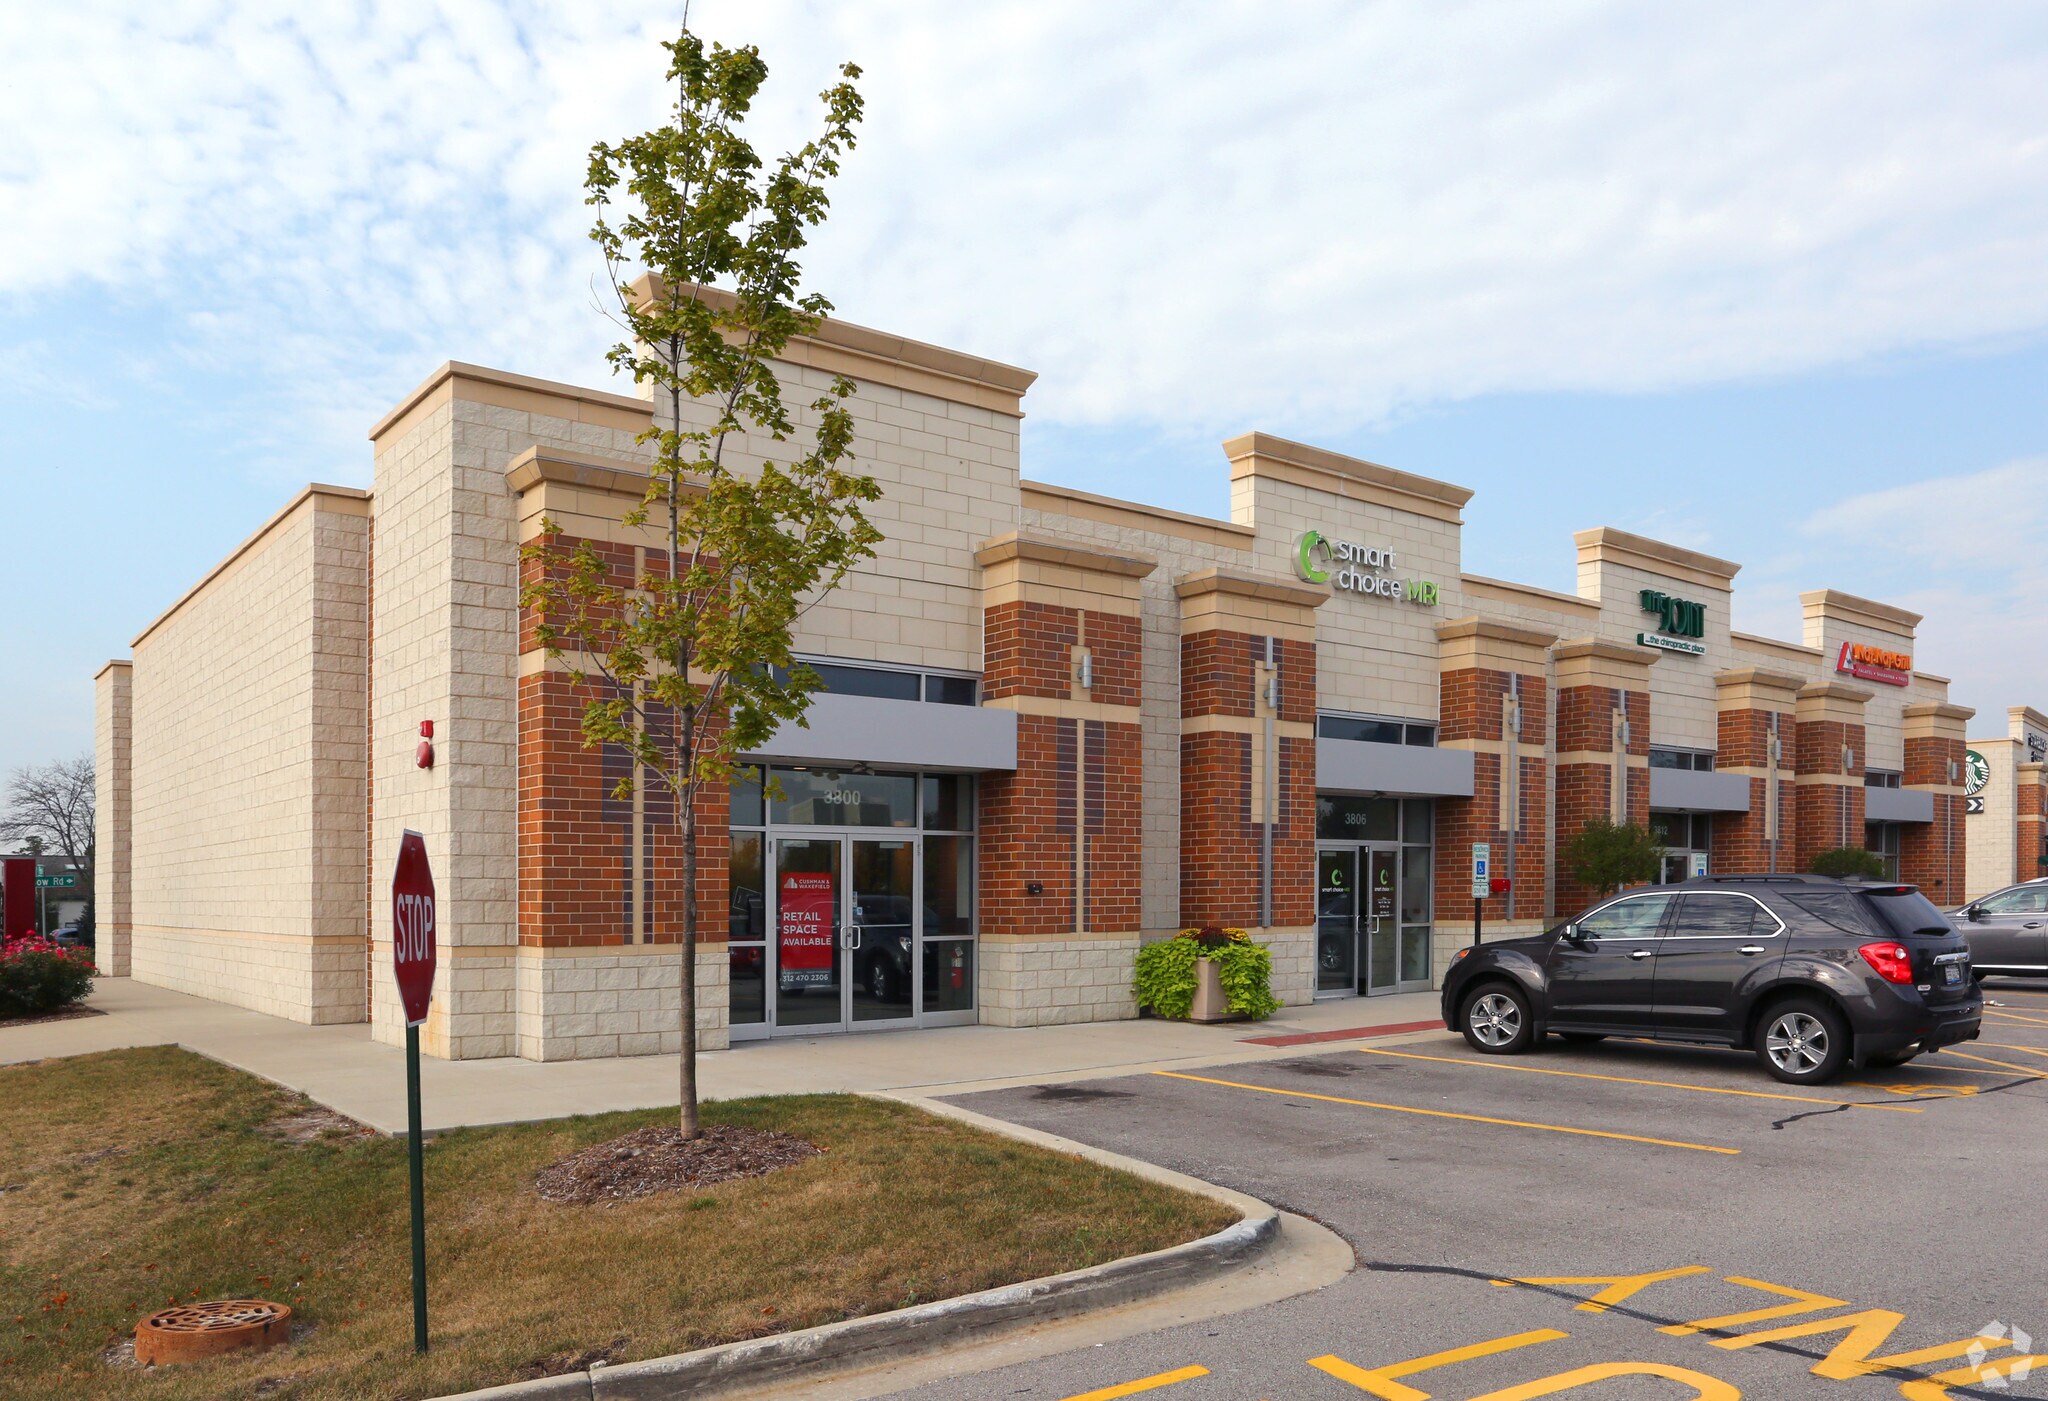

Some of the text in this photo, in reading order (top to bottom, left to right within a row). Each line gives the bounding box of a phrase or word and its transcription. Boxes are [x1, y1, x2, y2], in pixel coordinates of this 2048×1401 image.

[1337, 540, 1397, 570] smart
[1338, 565, 1440, 607] choice MRI
[824, 789, 861, 806] 3800
[1345, 813, 1367, 825] 3806
[1654, 825, 1668, 836] 3812
[53, 877, 64, 886] Rd
[783, 911, 821, 922] RETAIL
[396, 892, 433, 964] STOP
[783, 924, 818, 935] SPACE
[783, 937, 832, 947] AVAILABLE
[783, 974, 794, 983] 312
[796, 973, 810, 982] 470
[811, 972, 829, 981] 2306
